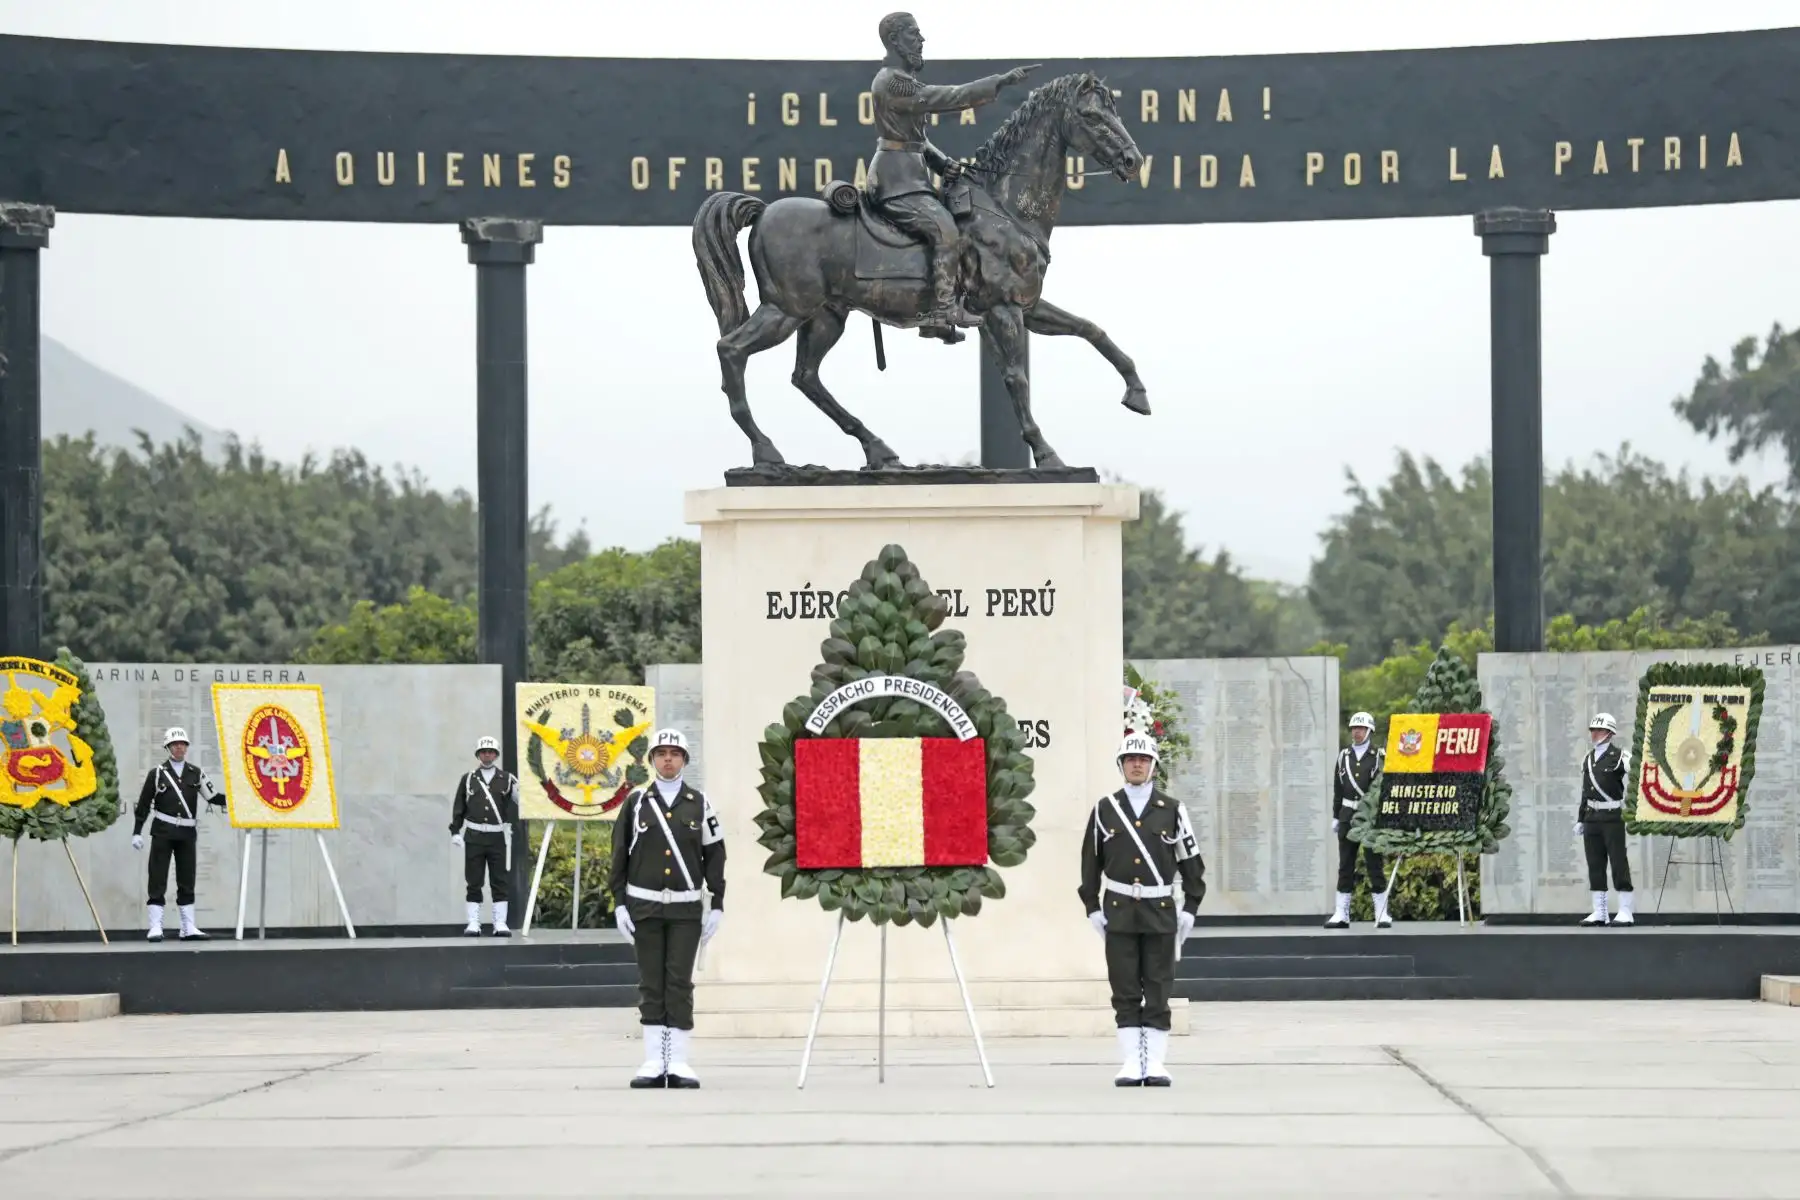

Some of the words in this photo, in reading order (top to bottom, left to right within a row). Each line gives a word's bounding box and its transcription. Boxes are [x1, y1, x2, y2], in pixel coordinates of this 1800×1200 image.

[275, 148, 291, 184] A
[335, 151, 571, 188] QUIENES
[1066, 156, 1084, 190] U
[1139, 154, 1256, 189] VIDA
[1306, 149, 1399, 187] POR
[1449, 144, 1505, 182] LA
[1554, 131, 1743, 175] PATRIA
[935, 588, 969, 617] EL
[985, 579, 1056, 617] PERÚ
[1735, 652, 1800, 667] EJER
[96, 668, 160, 682] ARINA
[174, 669, 200, 682] DE
[214, 669, 306, 683] GUERRA
[525, 688, 580, 718] MINISTERIO
[588, 688, 601, 697] DE
[608, 690, 648, 715] DEFENSA
[811, 680, 875, 729] DESPACHO
[884, 678, 973, 738] PRESIDENCIAL
[658, 732, 680, 745] PM
[1126, 739, 1146, 751] PM
[1436, 727, 1481, 755] PERU
[1390, 784, 1457, 799] MINISTERIO
[1381, 801, 1400, 815] DEL
[1407, 801, 1459, 815] INTERIOR
